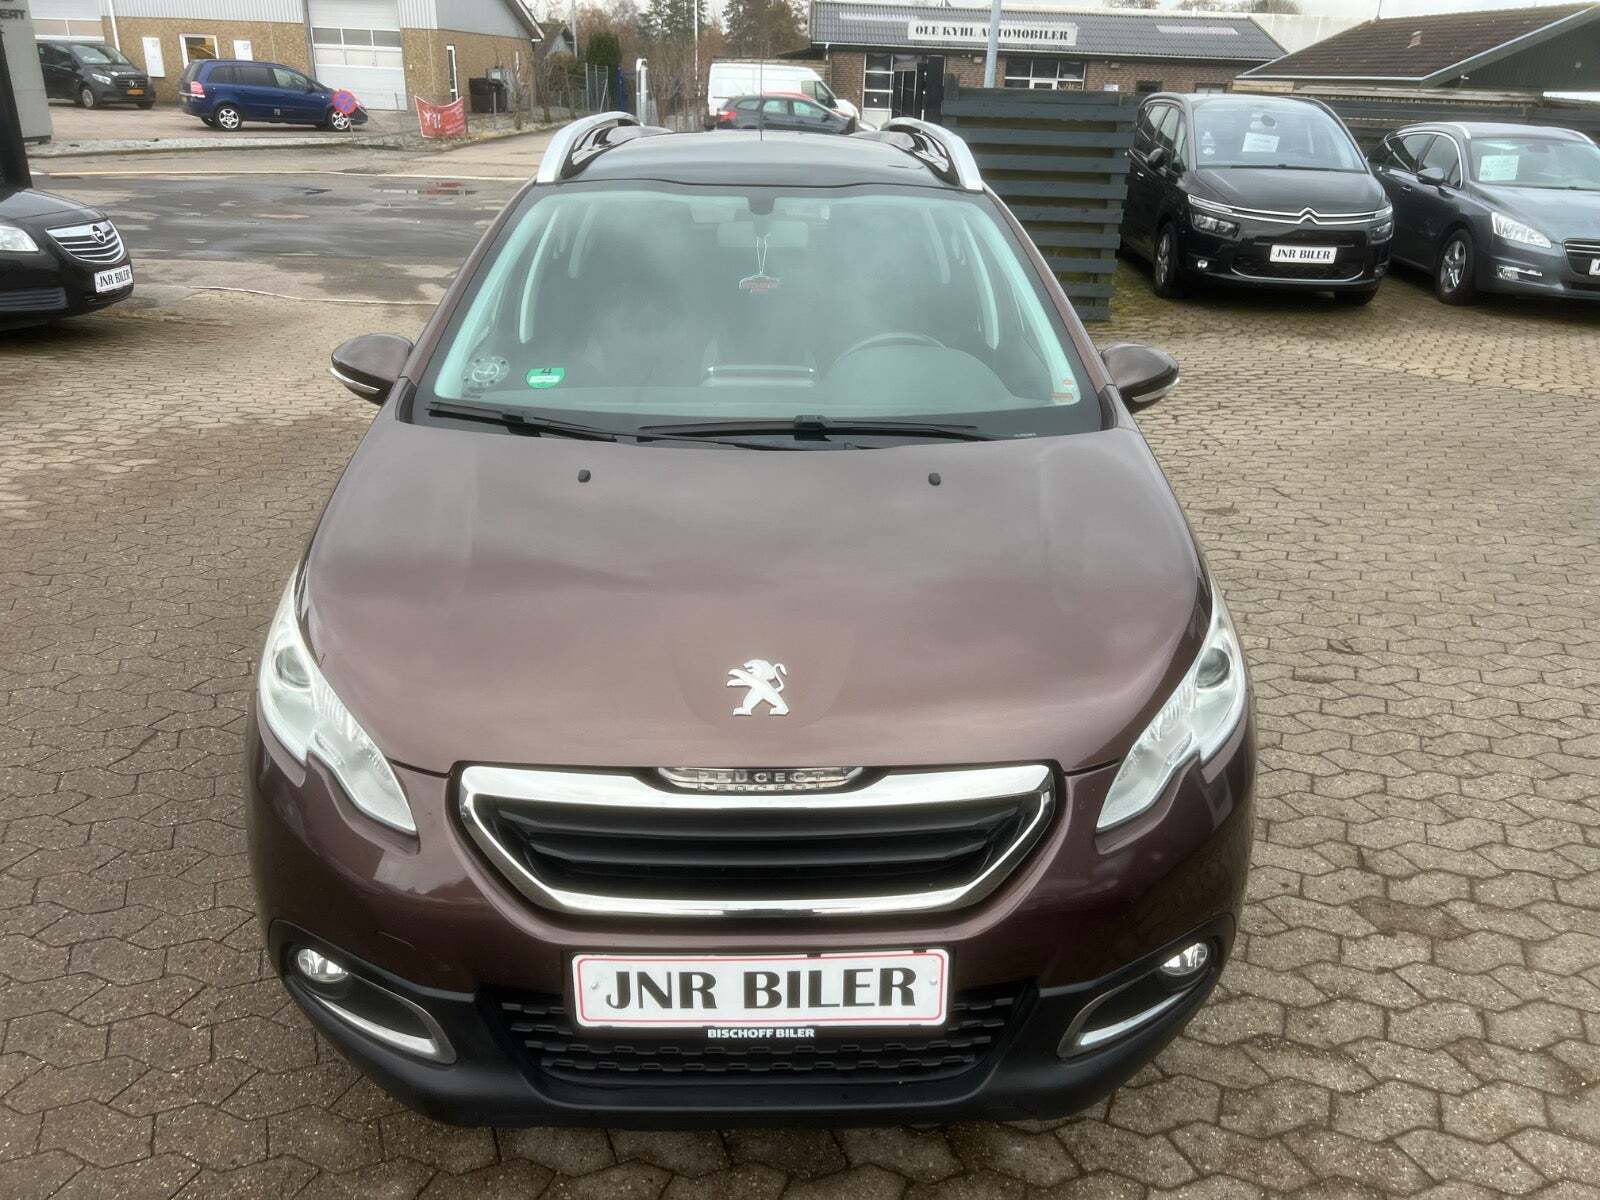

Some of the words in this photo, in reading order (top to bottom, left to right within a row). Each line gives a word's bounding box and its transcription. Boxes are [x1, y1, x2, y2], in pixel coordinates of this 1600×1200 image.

[915, 25, 939, 36] OLE
[980, 28, 1068, 41] ATOMOBILER
[1276, 248, 1296, 259] JNR
[1299, 249, 1331, 260] BILER
[98, 273, 114, 288] JNR
[697, 770, 825, 783] PEUGEOT
[605, 970, 718, 1010] JNR
[743, 967, 917, 1009] BILER
[707, 1028, 774, 1039] BISCHOFF
[775, 1028, 815, 1038] BILER
